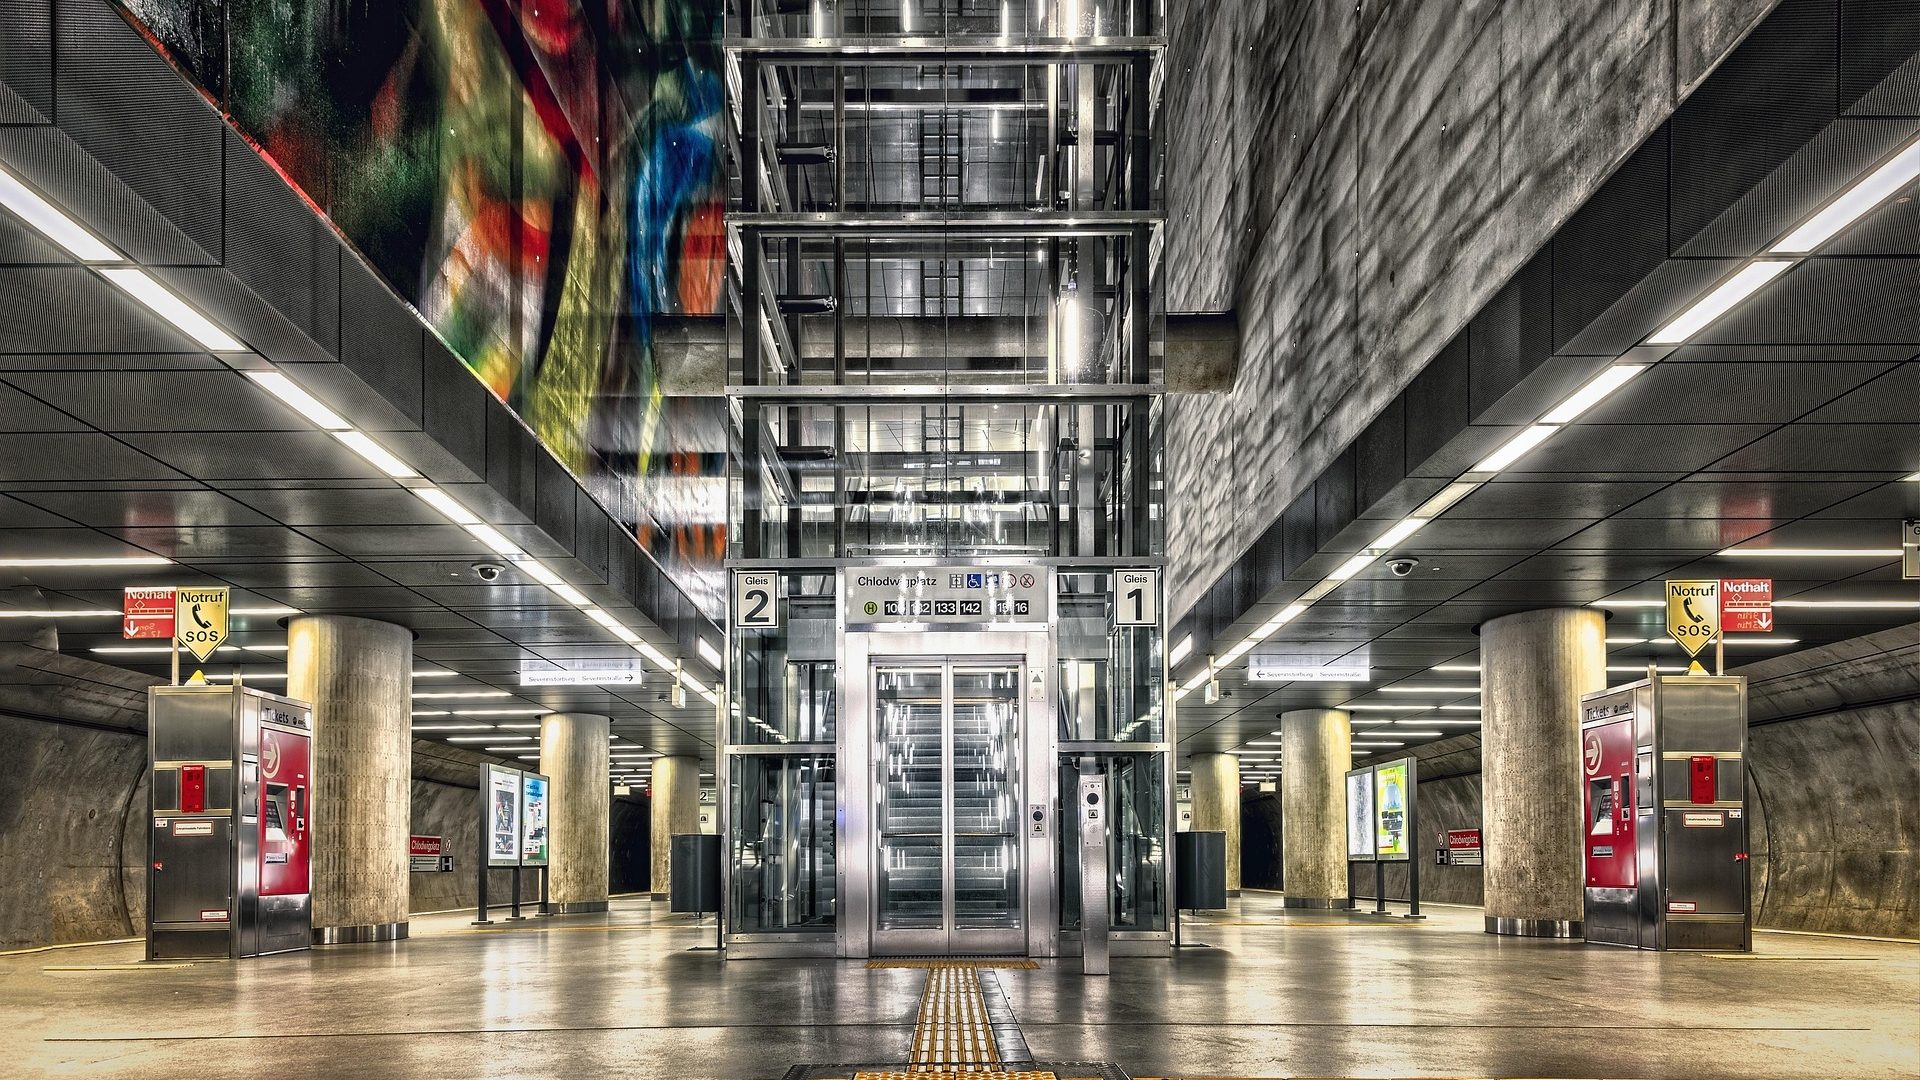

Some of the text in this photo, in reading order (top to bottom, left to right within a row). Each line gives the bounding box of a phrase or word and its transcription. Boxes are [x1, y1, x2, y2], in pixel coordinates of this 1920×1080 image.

[745, 576, 769, 585] Gleis
[858, 576, 937, 588] Chlodwgplatz
[1124, 574, 1148, 583] Gleis
[1671, 585, 1715, 596] Notruf
[1724, 582, 1769, 593] Nothalt
[180, 592, 224, 603] Notruf
[744, 589, 770, 623] 2
[935, 603, 956, 613] 133
[960, 603, 981, 613] 142
[1015, 603, 1028, 613] 16
[1127, 588, 1142, 621] 1
[185, 630, 218, 642] SOS
[1677, 625, 1711, 636] SOS
[265, 707, 289, 724] Tickets
[1586, 705, 1609, 720] Tickets
[700, 791, 707, 800] 2
[1436, 850, 1448, 864] H
[441, 857, 453, 871] H
